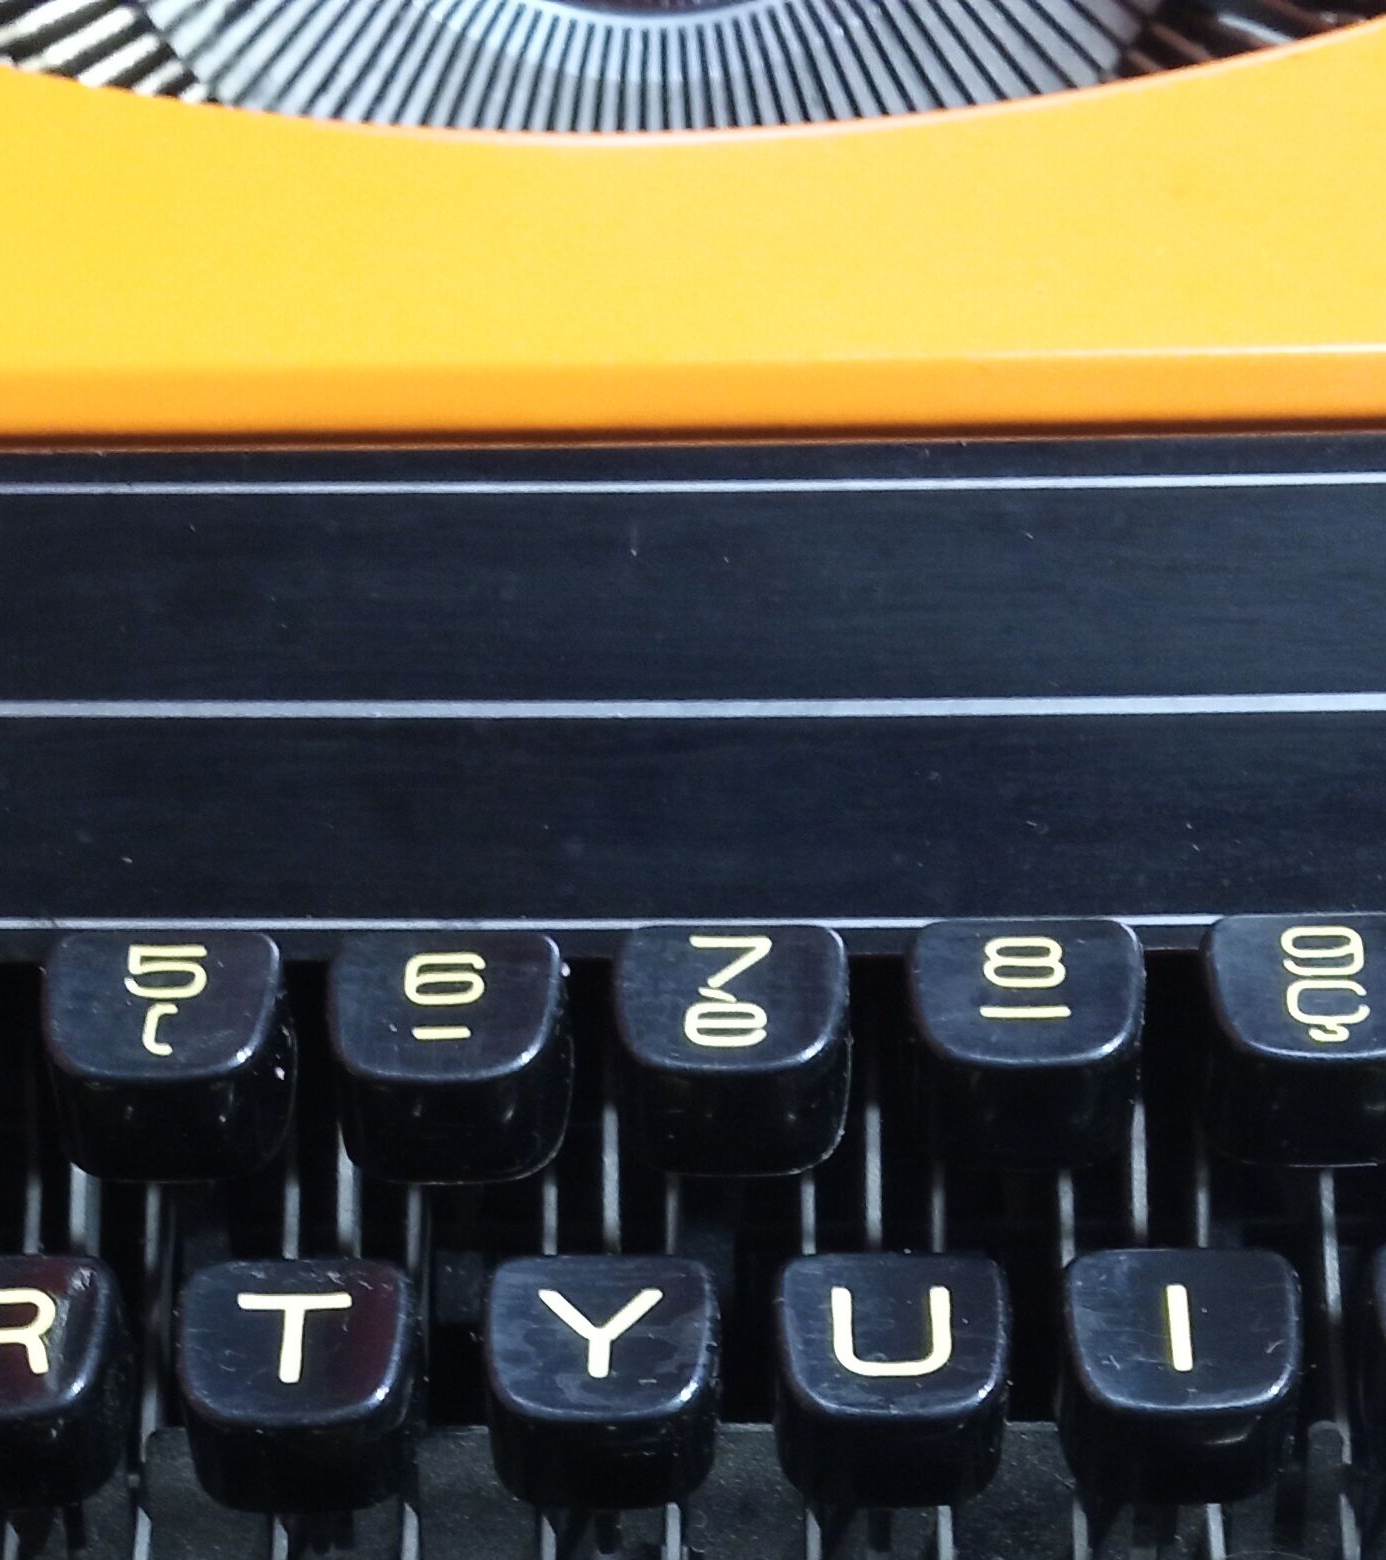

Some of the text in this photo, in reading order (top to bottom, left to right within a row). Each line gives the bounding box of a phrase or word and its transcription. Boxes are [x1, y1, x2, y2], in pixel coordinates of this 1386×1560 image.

[124, 945, 208, 999] 5
[688, 935, 773, 988] 7
[982, 936, 1066, 988] 8
[1280, 925, 1365, 976] 9
[403, 952, 486, 1005] 6
[237, 1292, 352, 1384] T
[538, 1288, 663, 1379] Y
[830, 1286, 952, 1377] U
[1166, 1284, 1193, 1372] I
